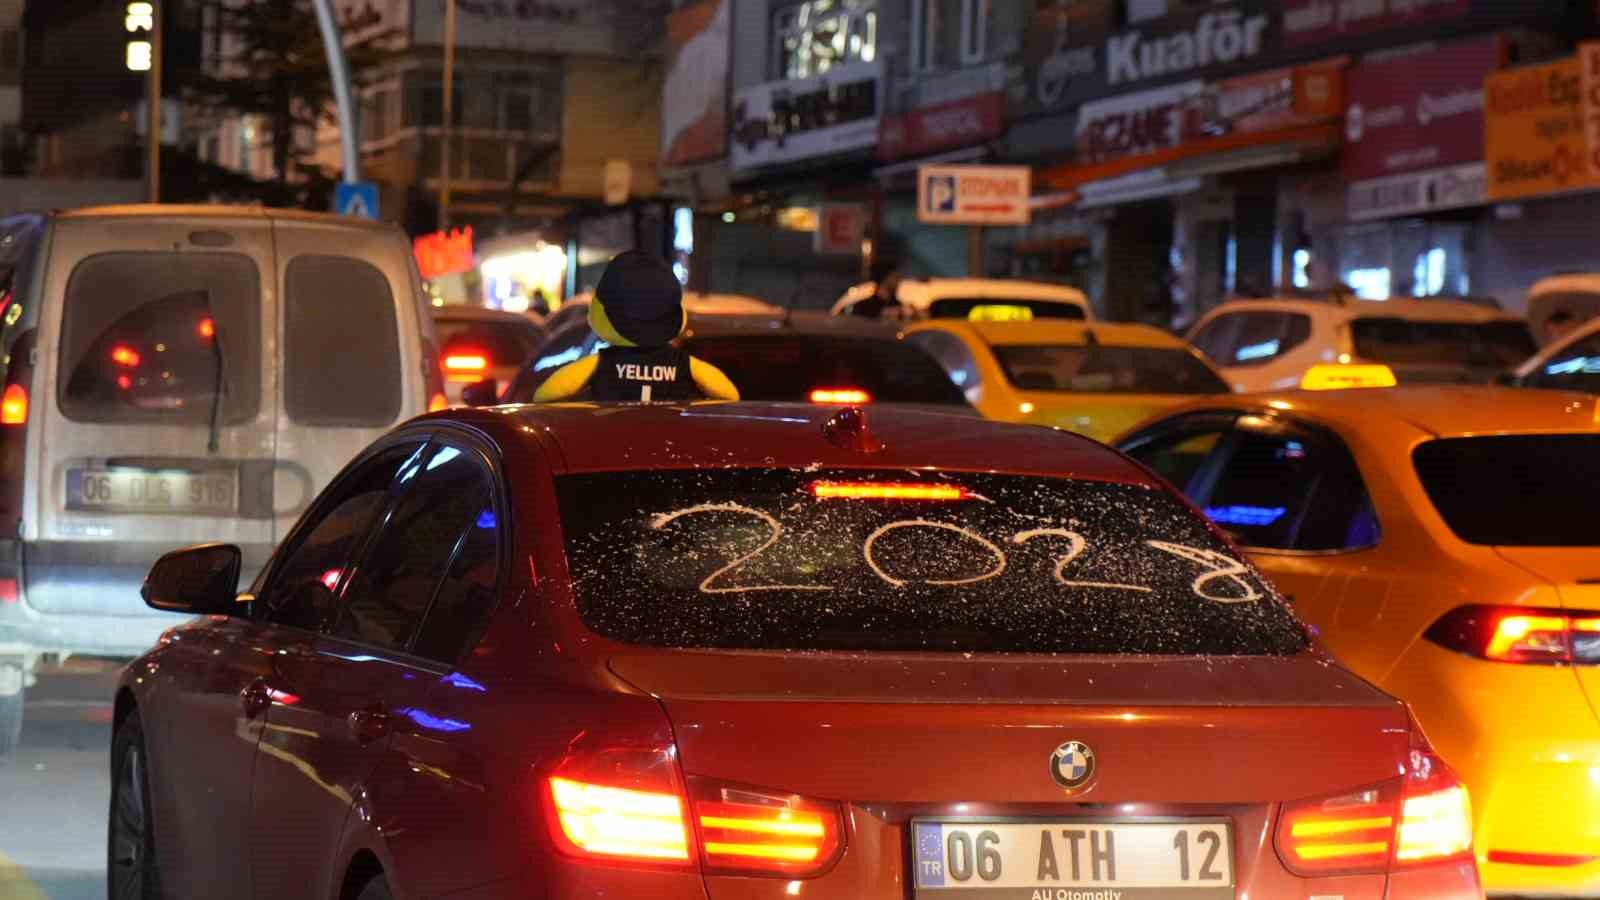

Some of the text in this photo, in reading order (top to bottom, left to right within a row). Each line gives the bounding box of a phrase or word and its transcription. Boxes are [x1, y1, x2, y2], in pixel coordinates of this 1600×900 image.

[1107, 12, 1267, 84] Kuaför
[616, 364, 677, 381] YELLOW
[83, 475, 112, 501] 06
[947, 830, 1223, 882] 06 ATH 12
[921, 861, 942, 875] TR
[1031, 889, 1052, 900] AU
